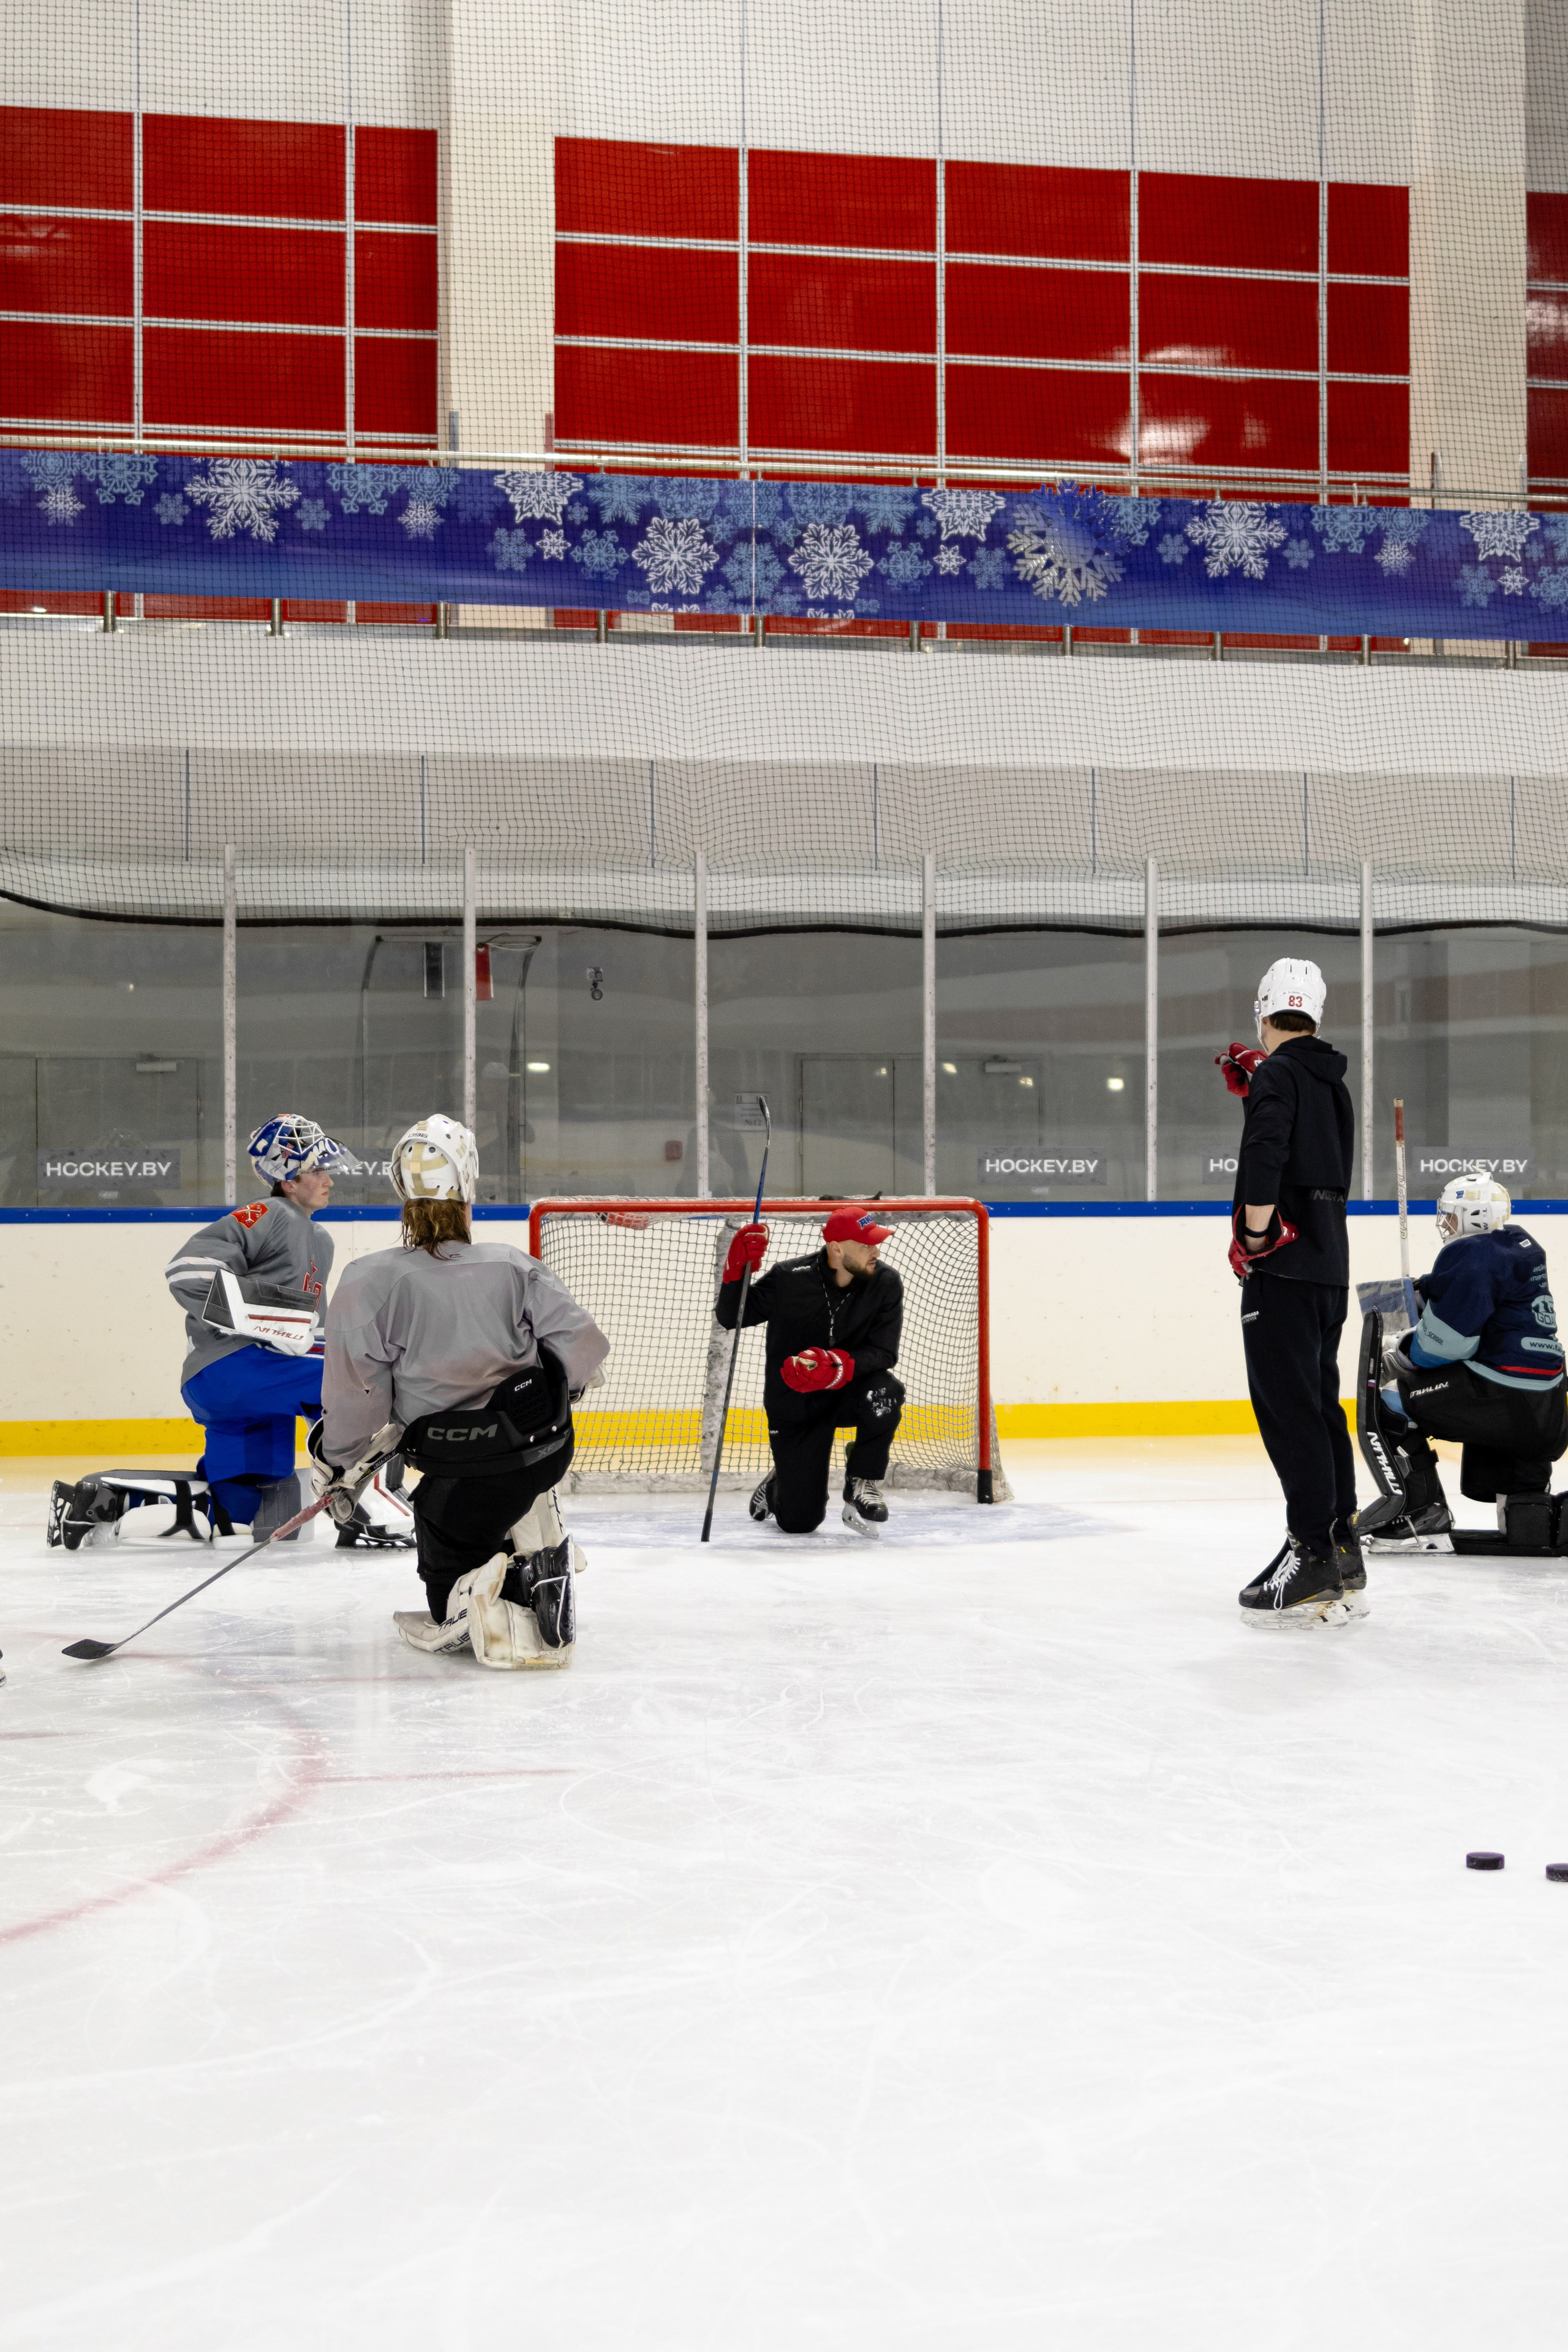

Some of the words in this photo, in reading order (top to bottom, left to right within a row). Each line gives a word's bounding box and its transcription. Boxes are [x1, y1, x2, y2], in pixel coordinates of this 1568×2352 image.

[1288, 995, 1303, 1008] 83
[46, 1161, 172, 1177] HOCKEY.BY
[986, 1159, 1099, 1173] HOCKEY.BY
[1420, 1159, 1528, 1173] HOCKEY.BY
[514, 1378, 532, 1392] CCM
[427, 1423, 498, 1441] CCM
